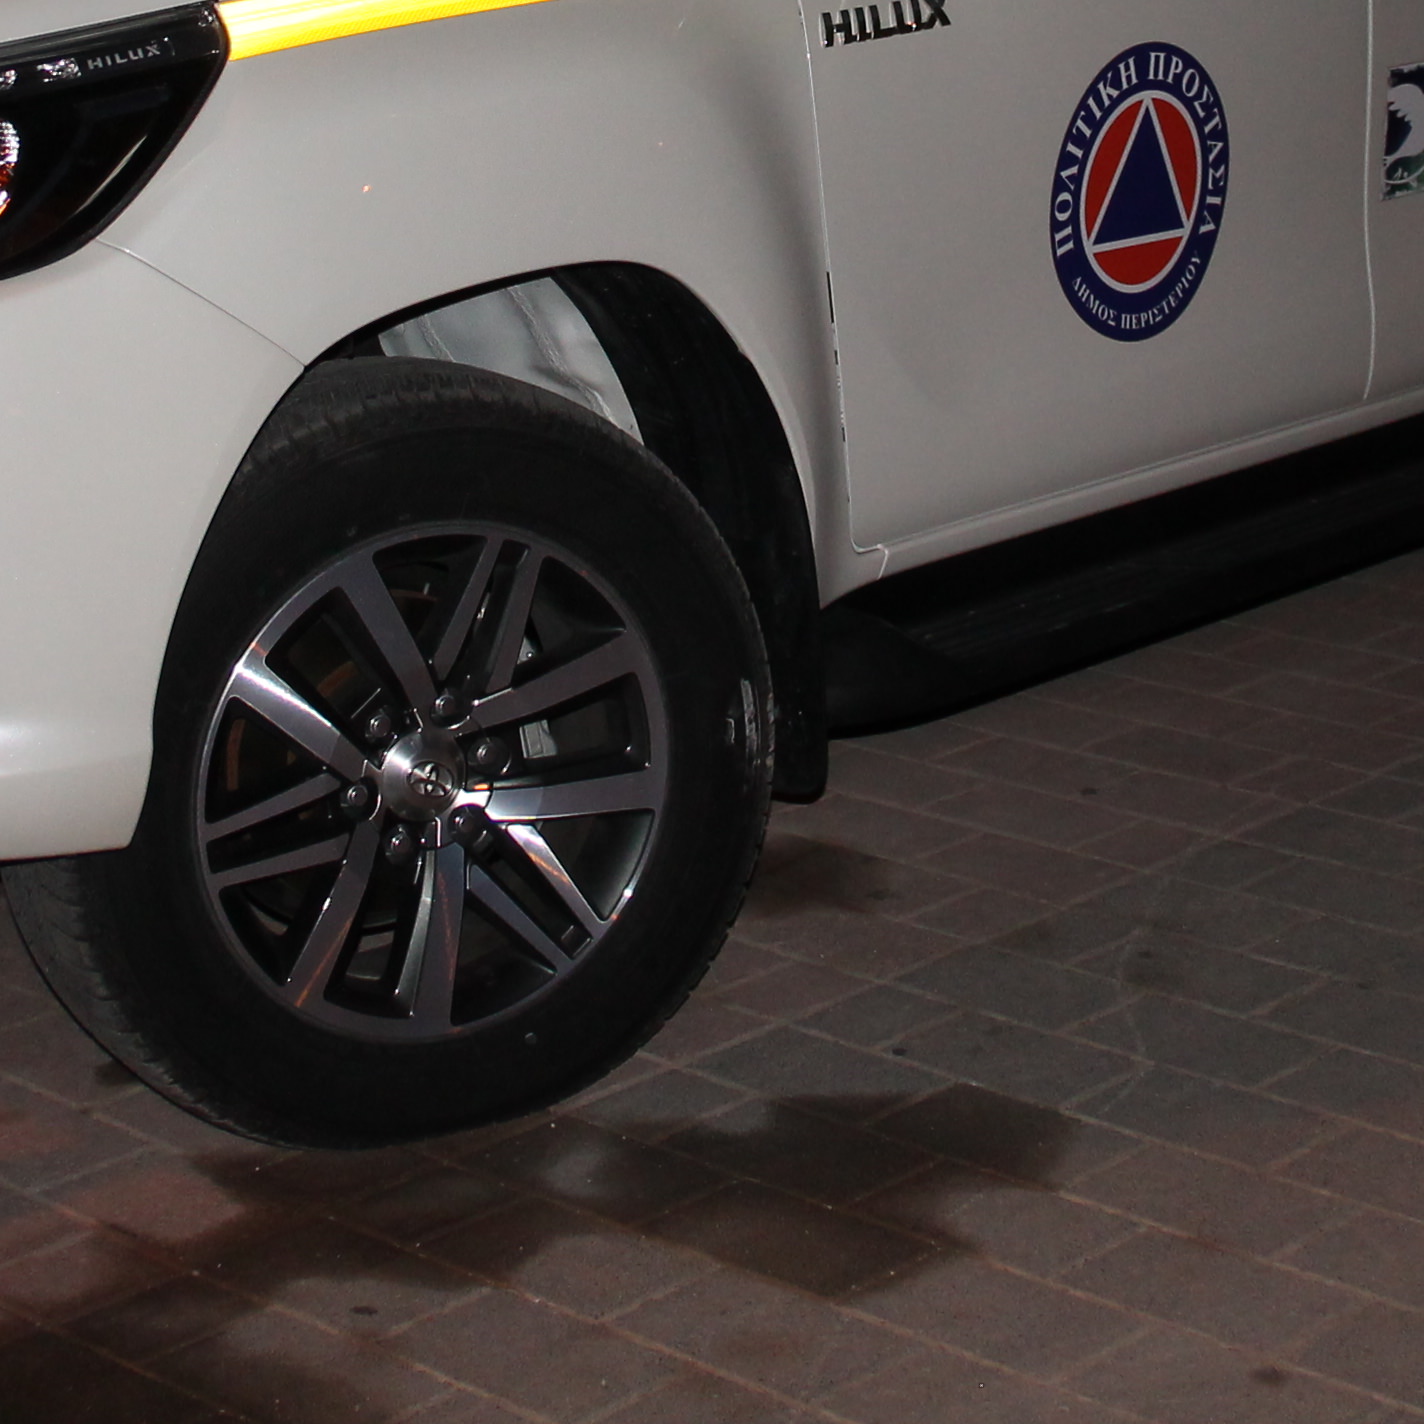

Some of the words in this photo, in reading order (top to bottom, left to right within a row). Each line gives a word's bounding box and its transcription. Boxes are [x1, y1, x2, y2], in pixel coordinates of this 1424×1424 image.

[87, 42, 161, 70] HILUX
[1054, 56, 1138, 258] ΠΟΛΙΤΙΚΗ
[1147, 52, 1225, 234] ΠΡΟΣΤΑΣΙΑ
[1072, 277, 1116, 326] ΔΗΜΟΣ
[1121, 250, 1202, 329] ΠΕΡΙΣΤΕΡΙΟΥ
